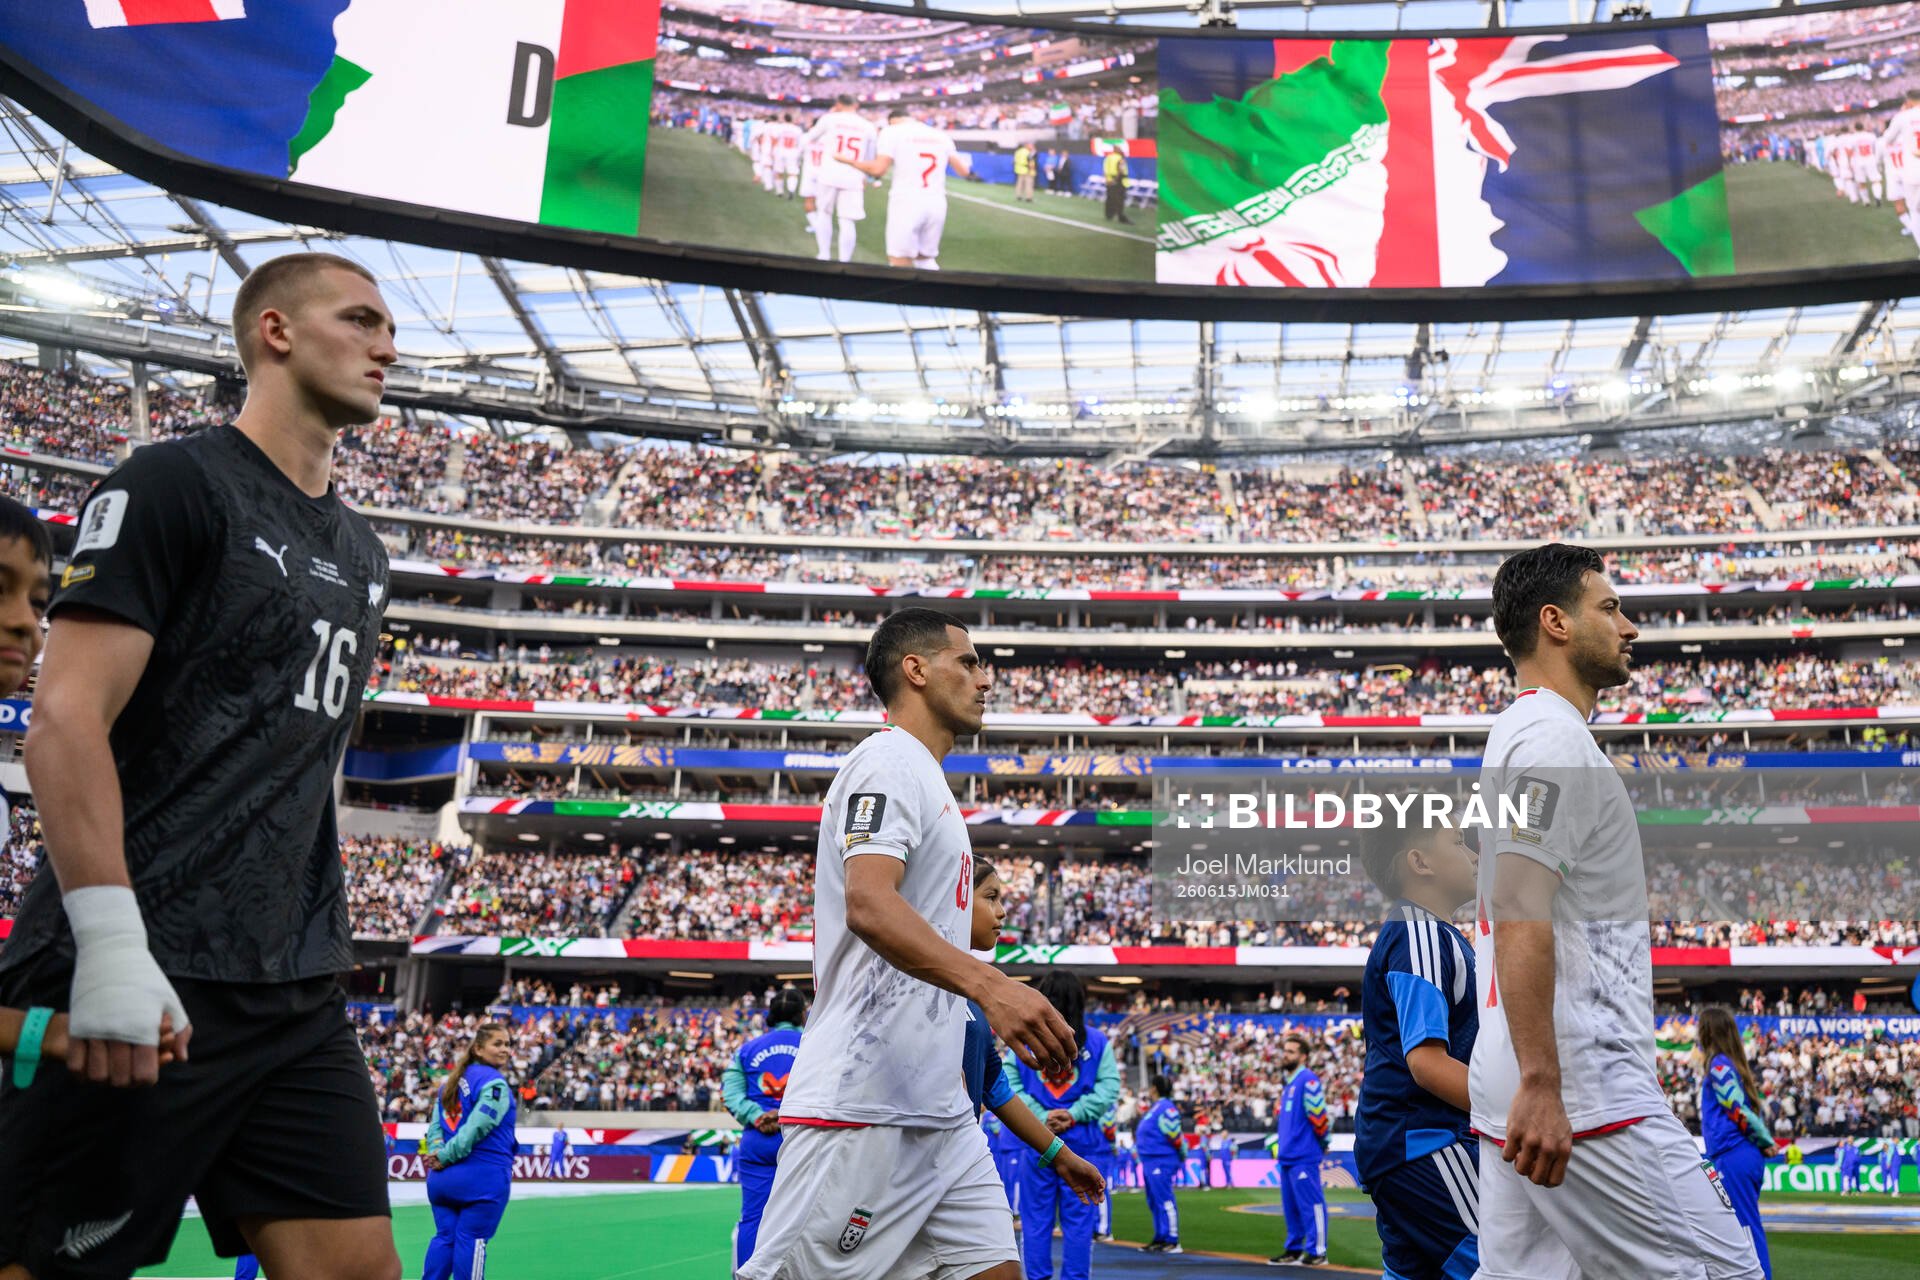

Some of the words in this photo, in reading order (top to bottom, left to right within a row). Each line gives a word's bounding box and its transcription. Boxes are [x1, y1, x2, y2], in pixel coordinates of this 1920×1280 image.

[506, 40, 556, 128] D
[918, 152, 937, 189] 7
[293, 618, 358, 720] 16
[1281, 759, 1333, 774] LOS
[1336, 759, 1453, 774] ANGELES
[1780, 1018, 1818, 1034] FIFA
